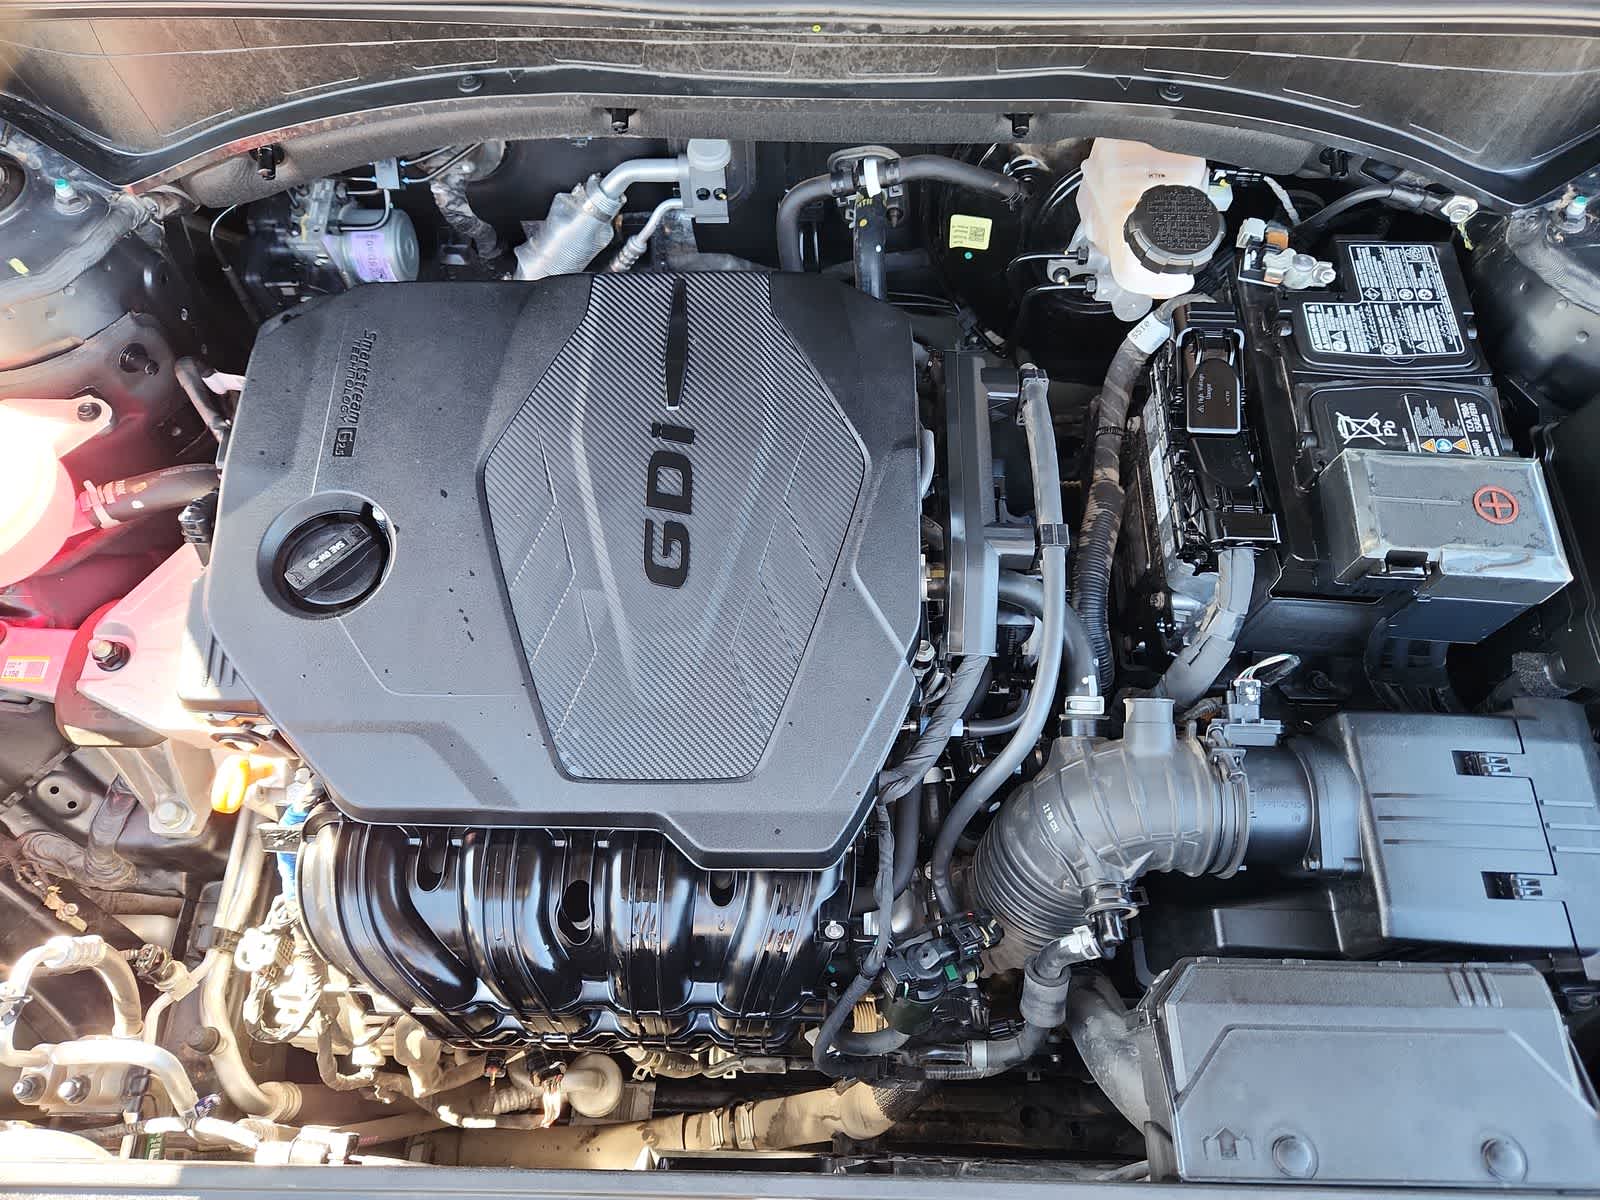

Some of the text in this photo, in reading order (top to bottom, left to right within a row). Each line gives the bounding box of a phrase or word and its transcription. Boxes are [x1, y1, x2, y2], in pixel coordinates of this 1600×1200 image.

[340, 339, 361, 424] TECHNOLOGY
[347, 328, 377, 425] Smartstream
[1383, 420, 1398, 437] Pb
[1465, 419, 1475, 432] CCA
[644, 422, 695, 589] GDi
[308, 540, 346, 570] SAE 0W-20
